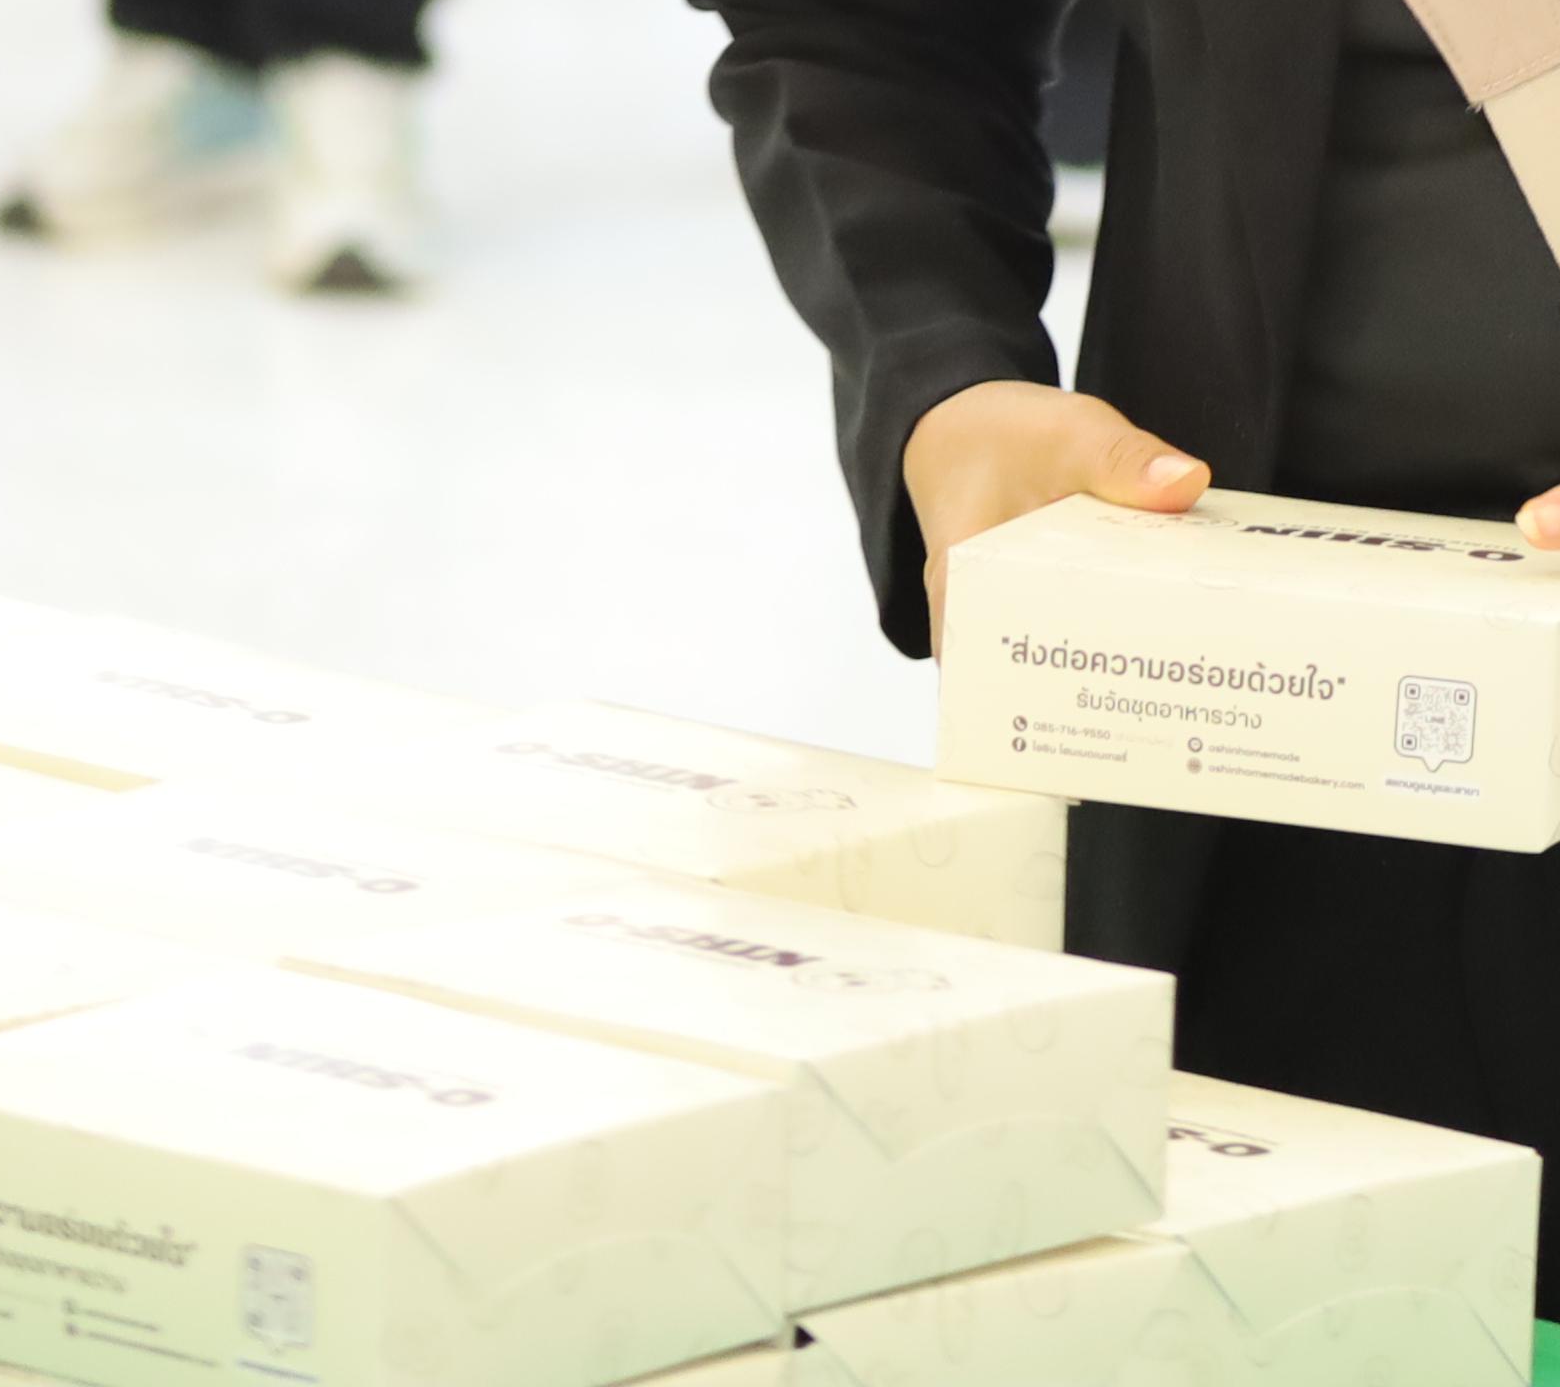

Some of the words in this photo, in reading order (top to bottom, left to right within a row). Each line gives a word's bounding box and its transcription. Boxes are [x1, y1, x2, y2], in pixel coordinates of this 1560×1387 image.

[1001, 634, 1347, 701] "ส่งต่อความอร่อยด้วยใจ"
[1075, 689, 1264, 731] รับจัดชุดอาหารว่าง
[1032, 721, 1112, 742] 085-716-9550
